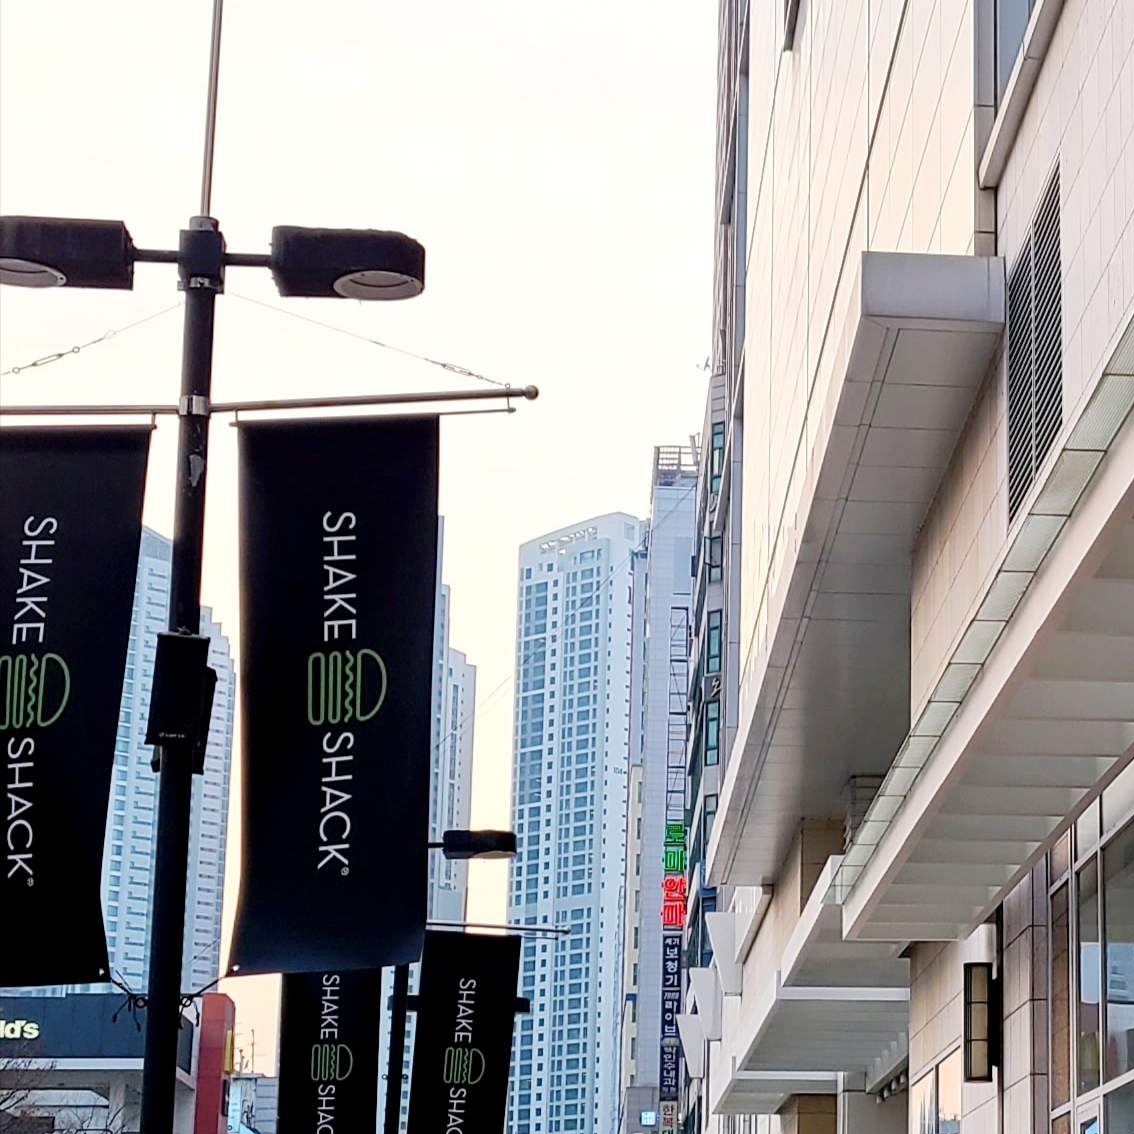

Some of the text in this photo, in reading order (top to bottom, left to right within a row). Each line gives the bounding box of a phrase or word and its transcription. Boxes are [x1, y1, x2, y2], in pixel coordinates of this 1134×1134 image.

[7, 515, 58, 879] SHAKE SHACK
[317, 511, 357, 870] SHAKE SHACK
[665, 946, 679, 986] 보청기
[320, 974, 340, 1040] SHAKE
[455, 978, 477, 1043] SHAKE
